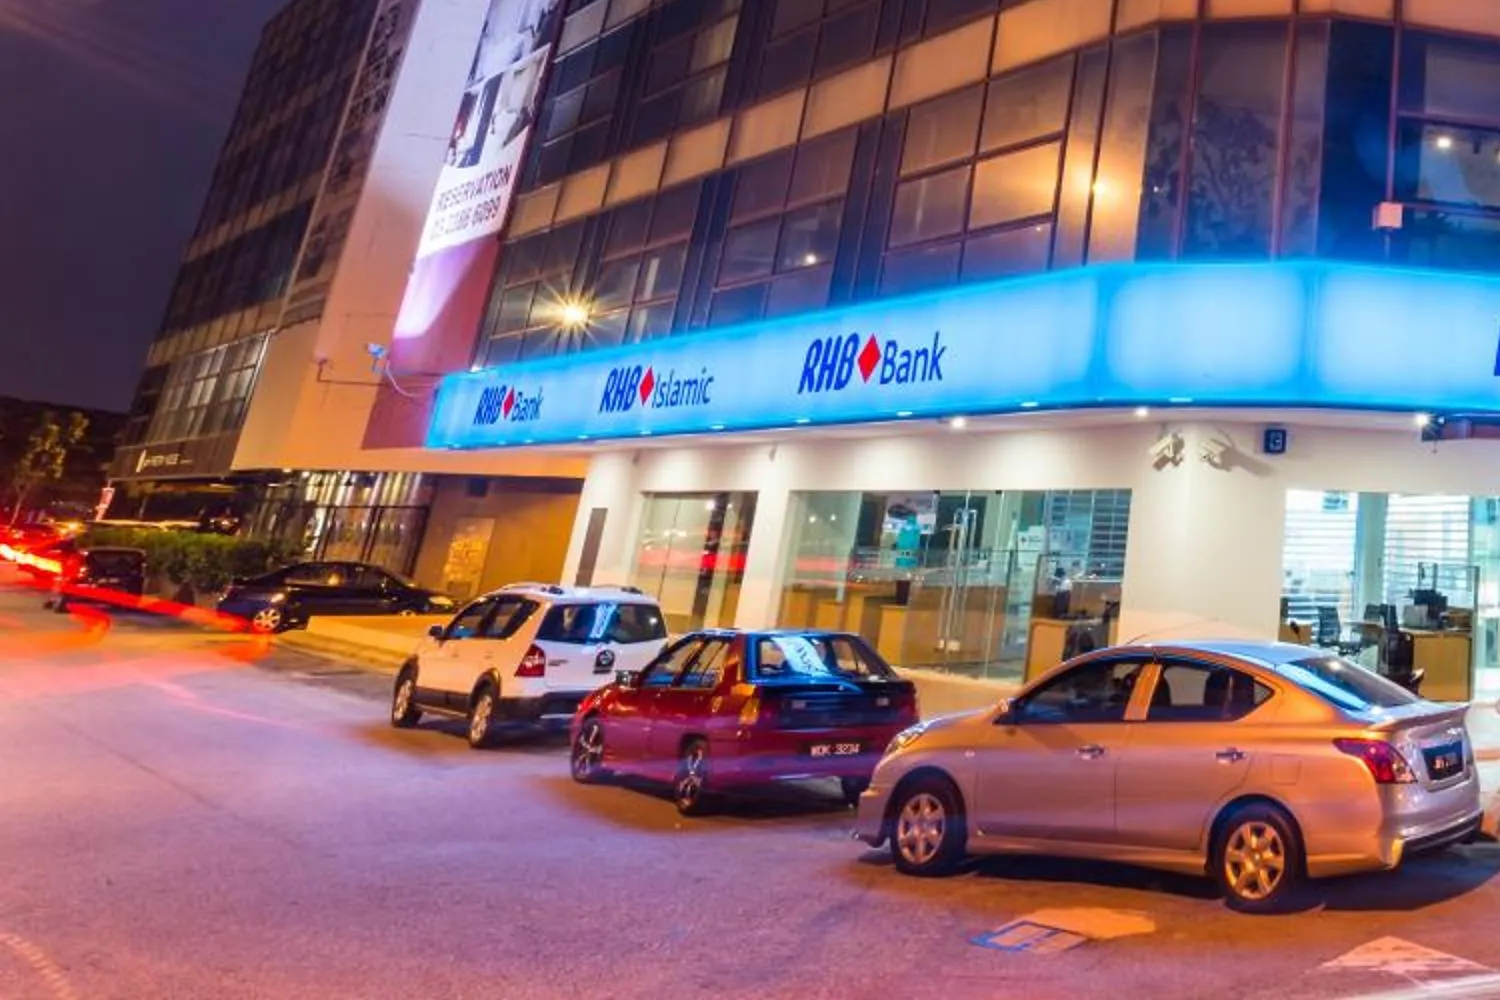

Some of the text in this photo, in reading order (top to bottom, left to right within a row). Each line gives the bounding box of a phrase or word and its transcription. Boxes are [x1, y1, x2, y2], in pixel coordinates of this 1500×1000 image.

[799, 331, 945, 394] RHB Bank
[473, 386, 543, 424] RHB Bank
[599, 365, 713, 413] RHB Islamic
